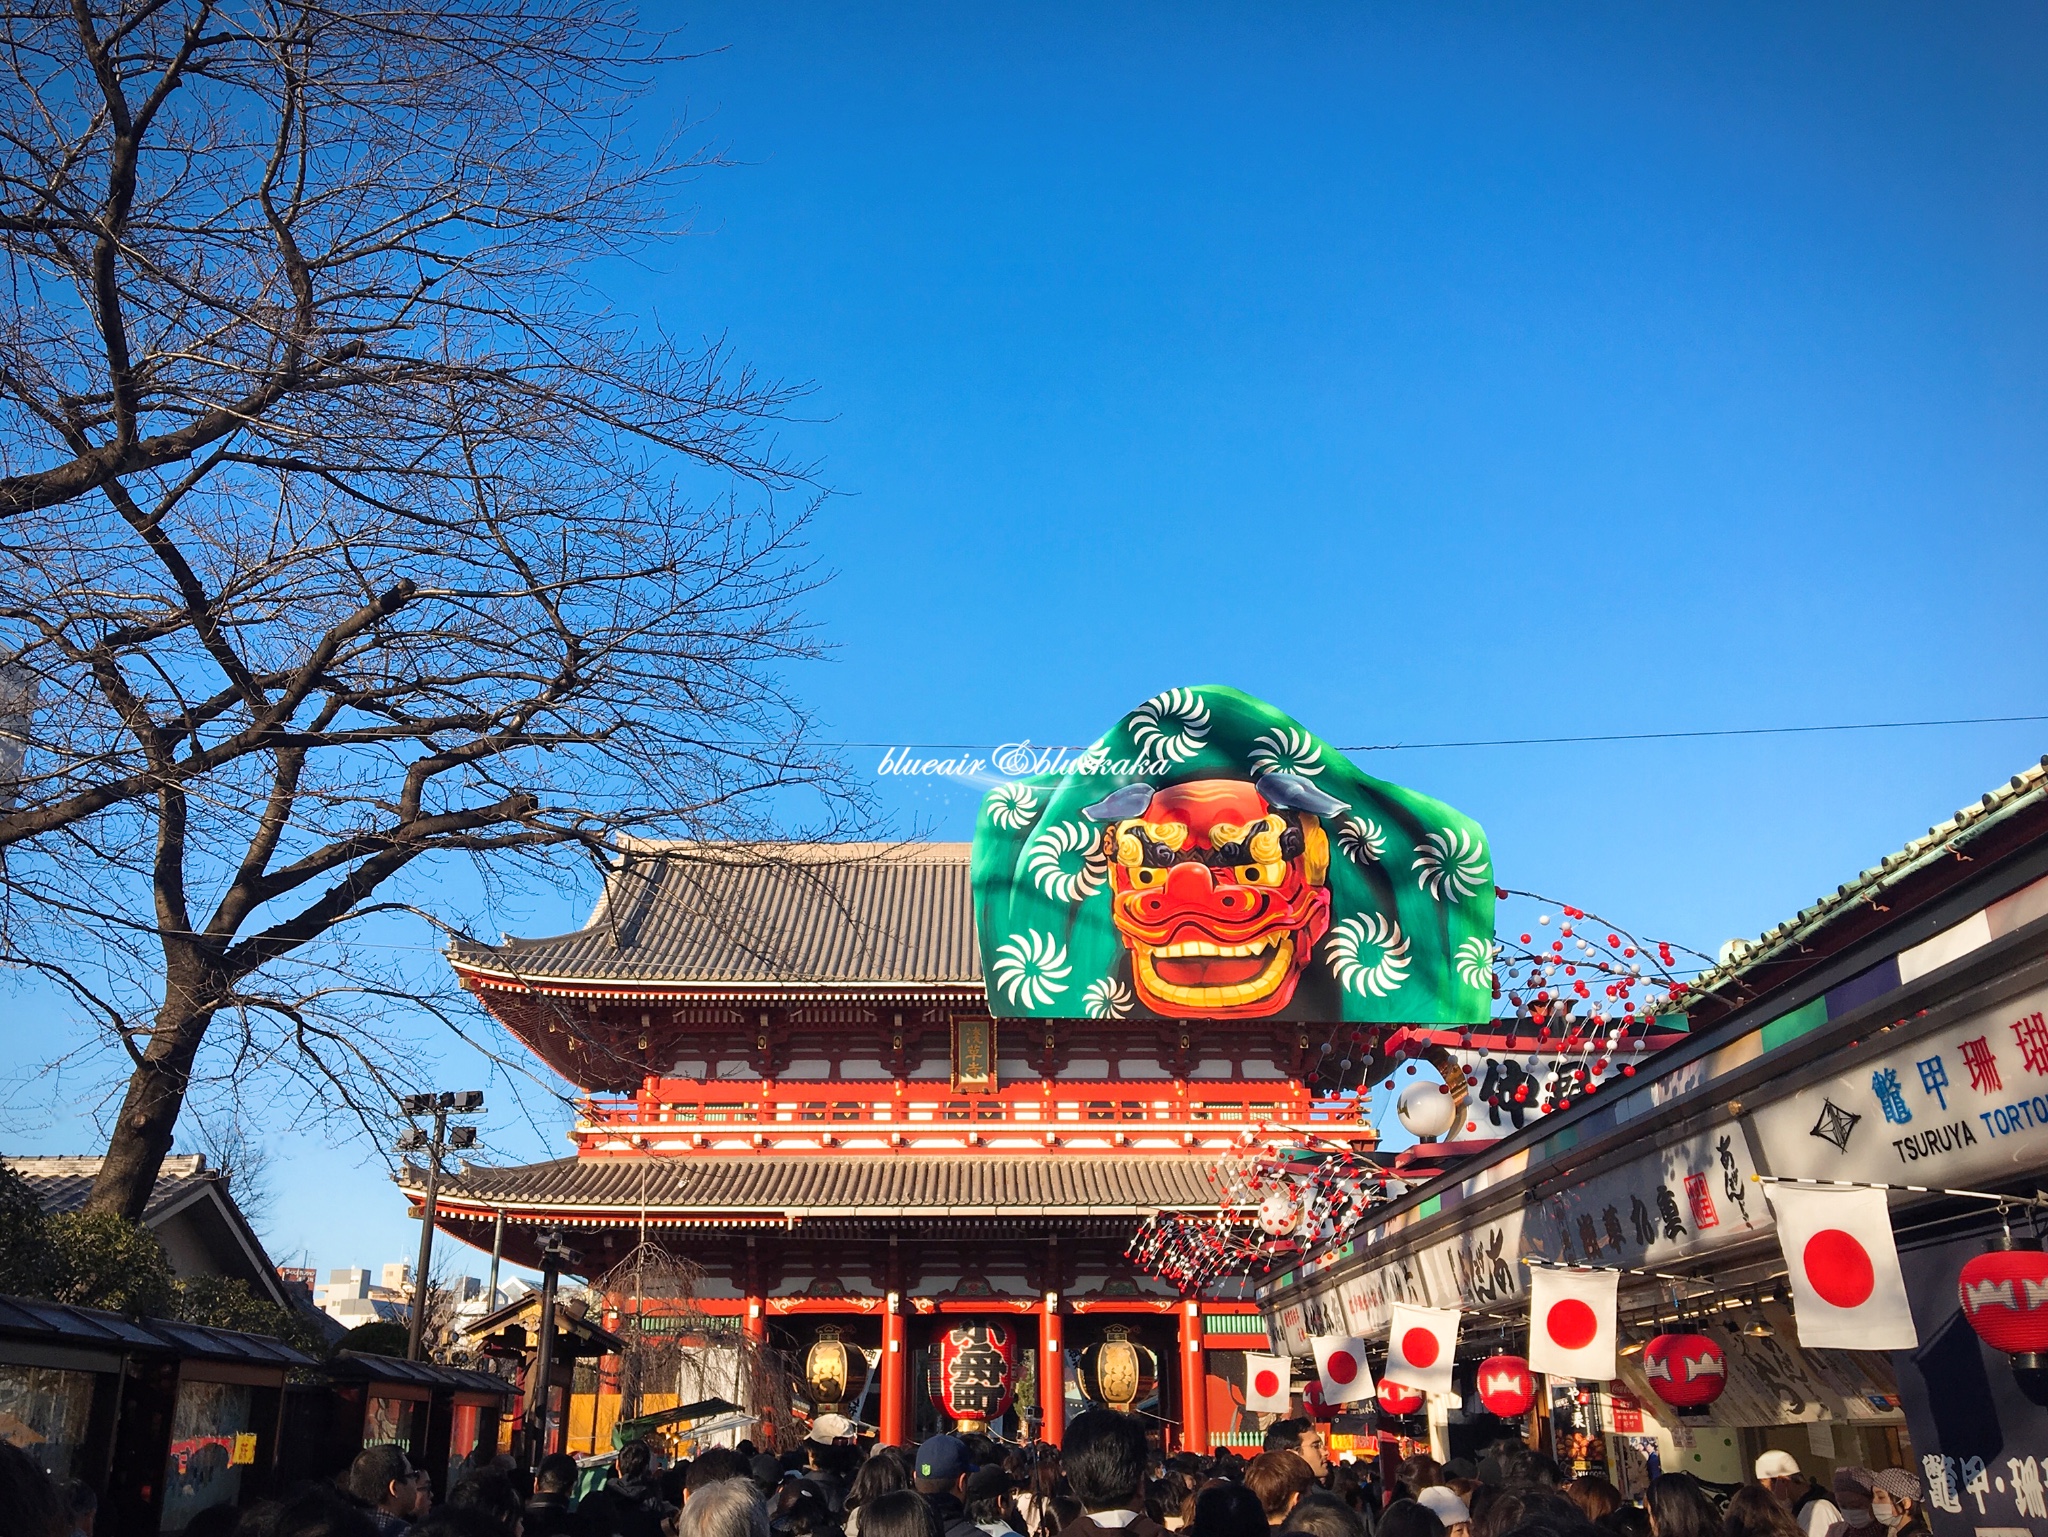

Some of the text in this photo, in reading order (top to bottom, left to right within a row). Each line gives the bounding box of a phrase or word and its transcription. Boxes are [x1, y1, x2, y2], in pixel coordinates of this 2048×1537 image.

[1892, 1094, 2048, 1164] TSURUYA TORTO
[948, 1320, 1008, 1418] 小舟町
[1921, 1453, 2048, 1520] 鼈甲・珊
